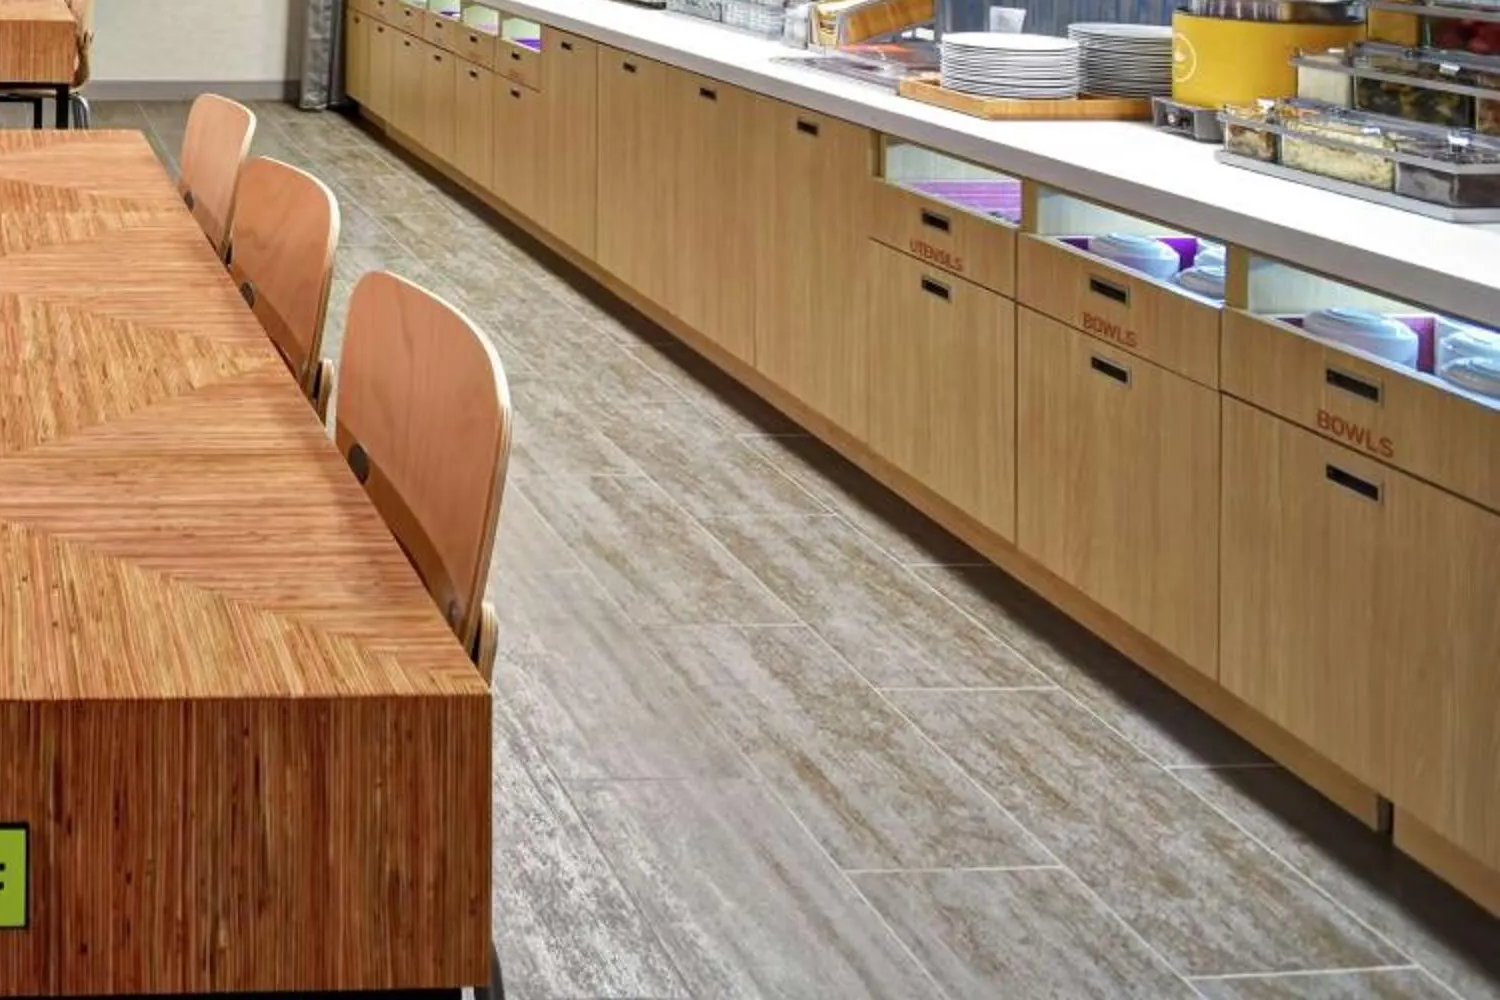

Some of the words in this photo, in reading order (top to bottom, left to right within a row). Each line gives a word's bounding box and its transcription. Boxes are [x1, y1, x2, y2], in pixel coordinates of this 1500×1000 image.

[908, 238, 964, 273] UTENSILS
[1082, 311, 1138, 348] BOWLS
[1316, 407, 1395, 459] BOWLS
